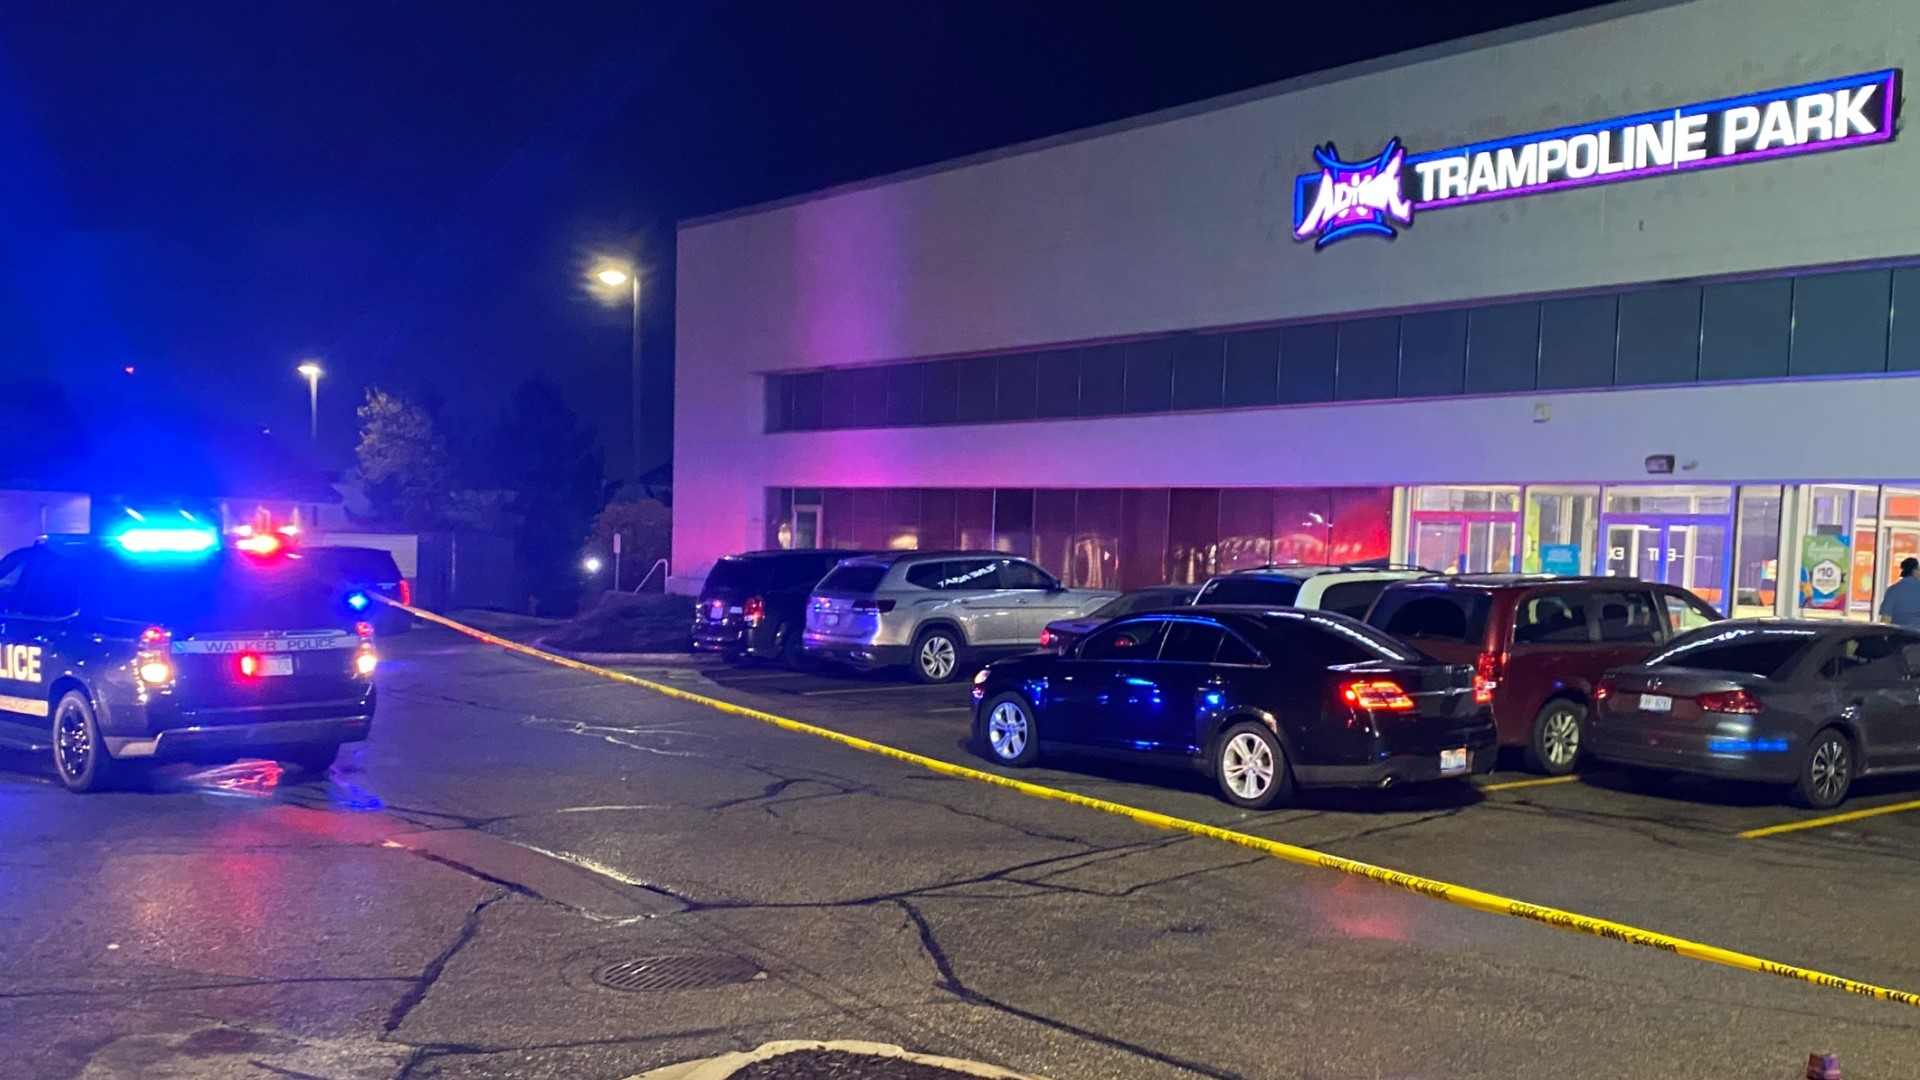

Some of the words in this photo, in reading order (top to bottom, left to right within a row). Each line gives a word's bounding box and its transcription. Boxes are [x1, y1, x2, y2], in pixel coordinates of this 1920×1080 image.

[1415, 113, 1708, 202] TRAMPOLINE
[1723, 84, 1878, 156] PARK
[205, 642, 277, 652] WALKER
[287, 638, 337, 650] POLICE
